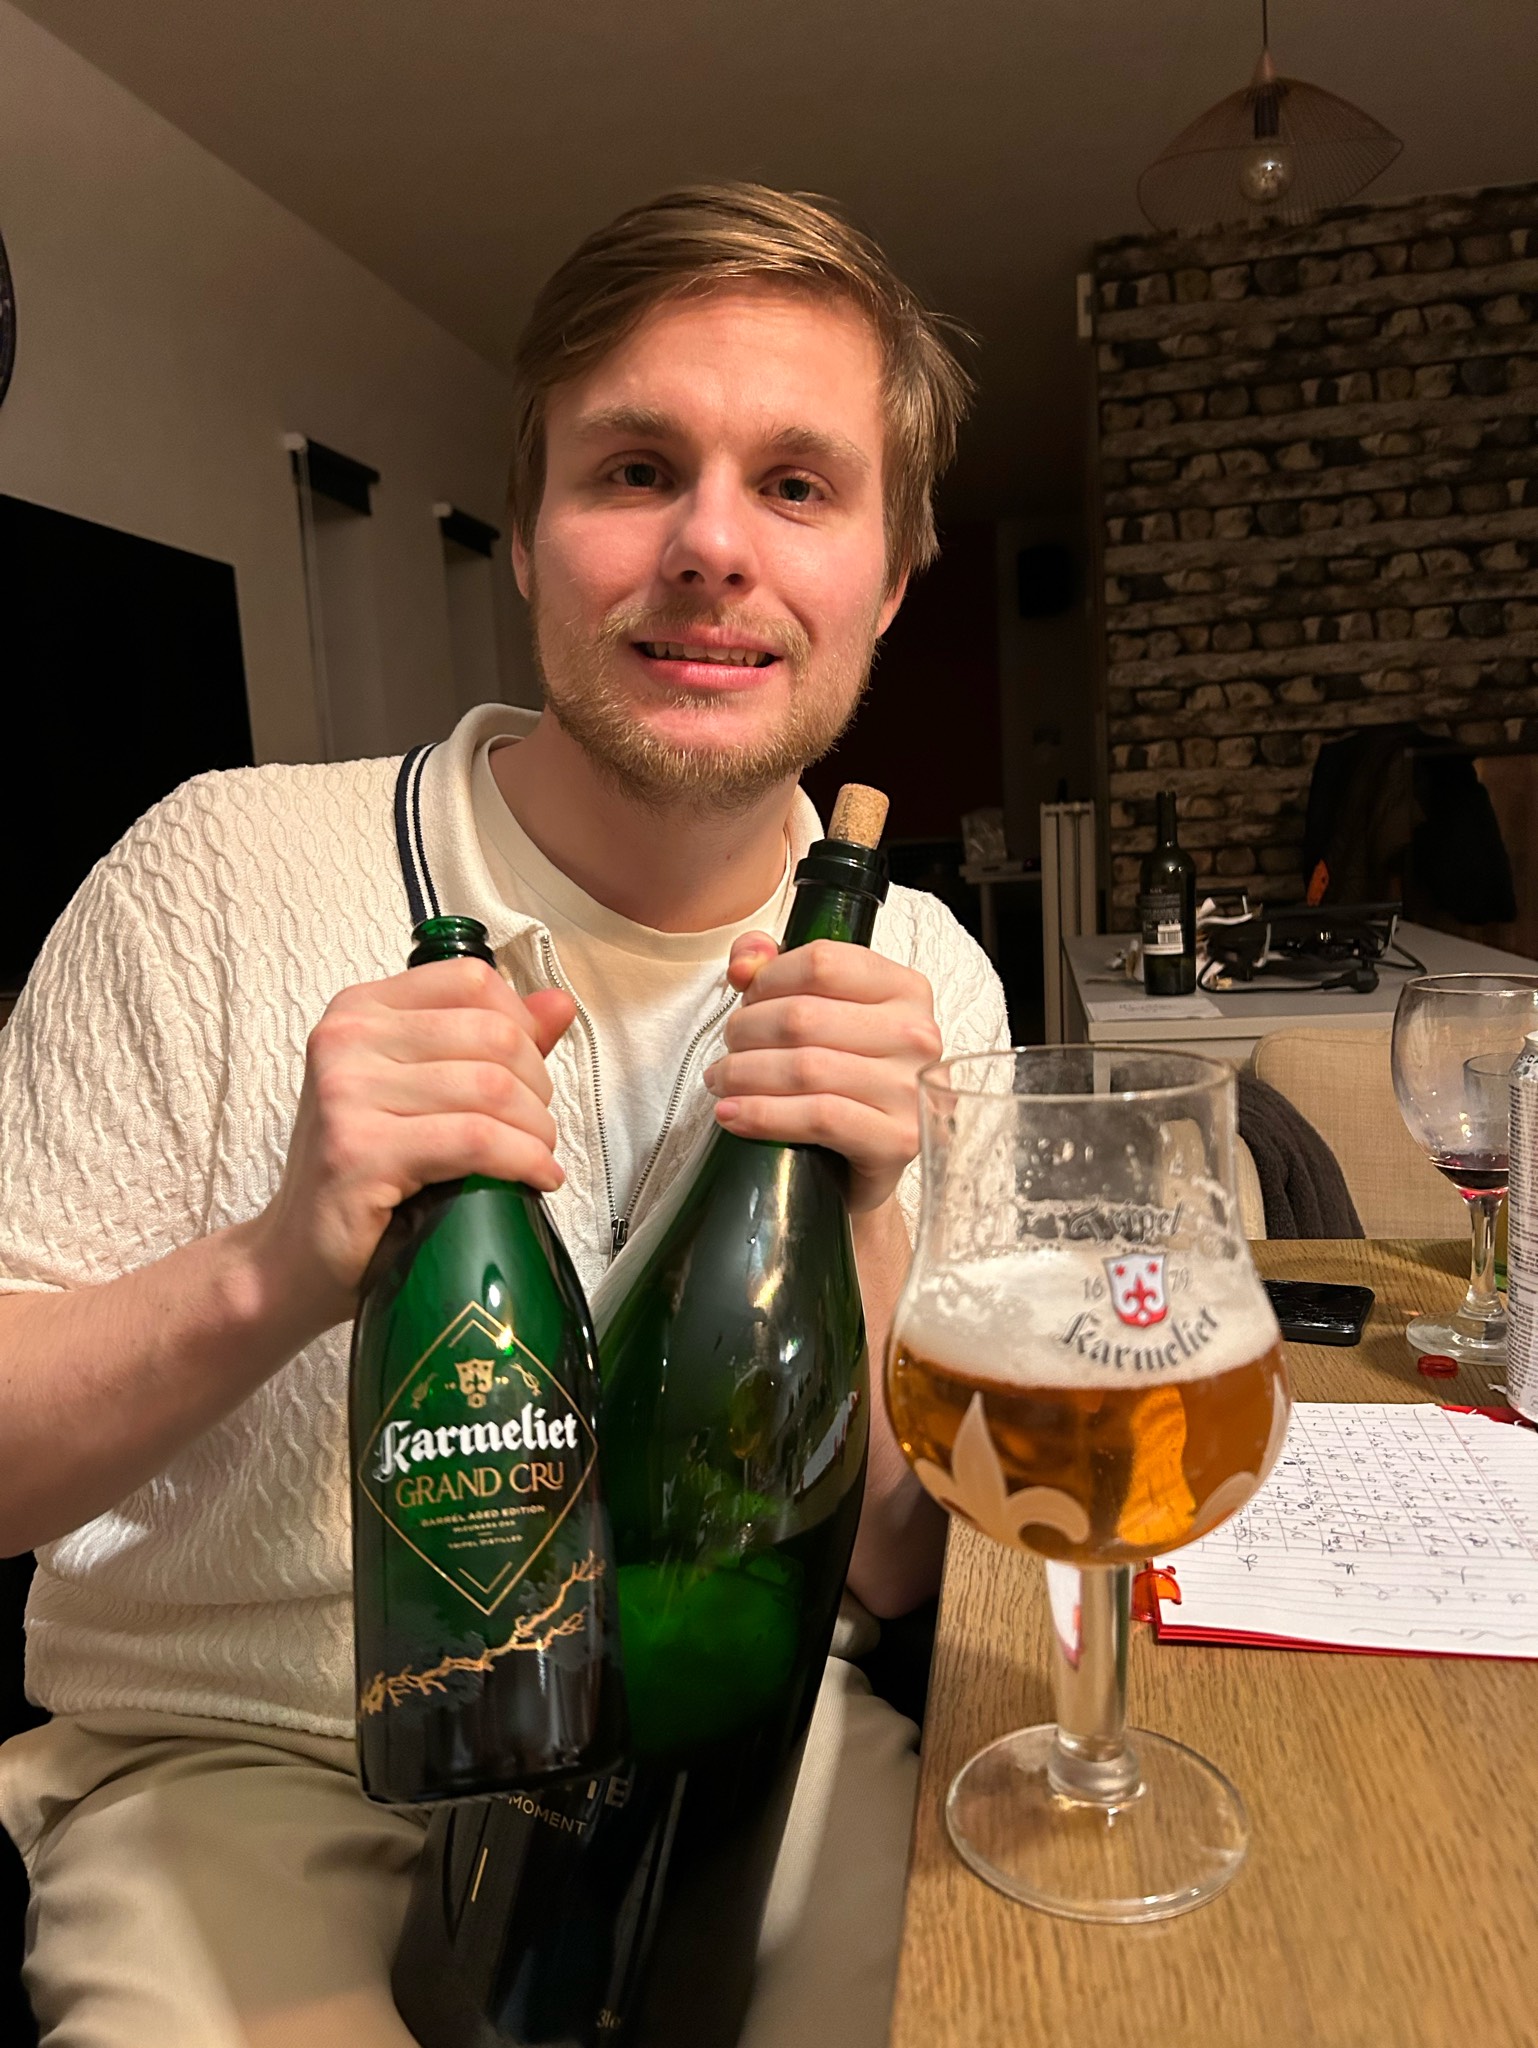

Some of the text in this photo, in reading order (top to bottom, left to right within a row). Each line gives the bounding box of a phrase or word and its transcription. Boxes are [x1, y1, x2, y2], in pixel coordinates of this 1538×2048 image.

[1071, 1199, 1184, 1243] Tripel
[1082, 1276, 1104, 1300] 16
[1061, 1306, 1218, 1371] Karmeliet
[372, 1402, 578, 1483] Karmeliet
[395, 1461, 565, 1508] GRAND CRU
[467, 1508, 500, 1521] AGED
[501, 1503, 546, 1517] EDITION
[508, 1795, 588, 1836] MOMENT
